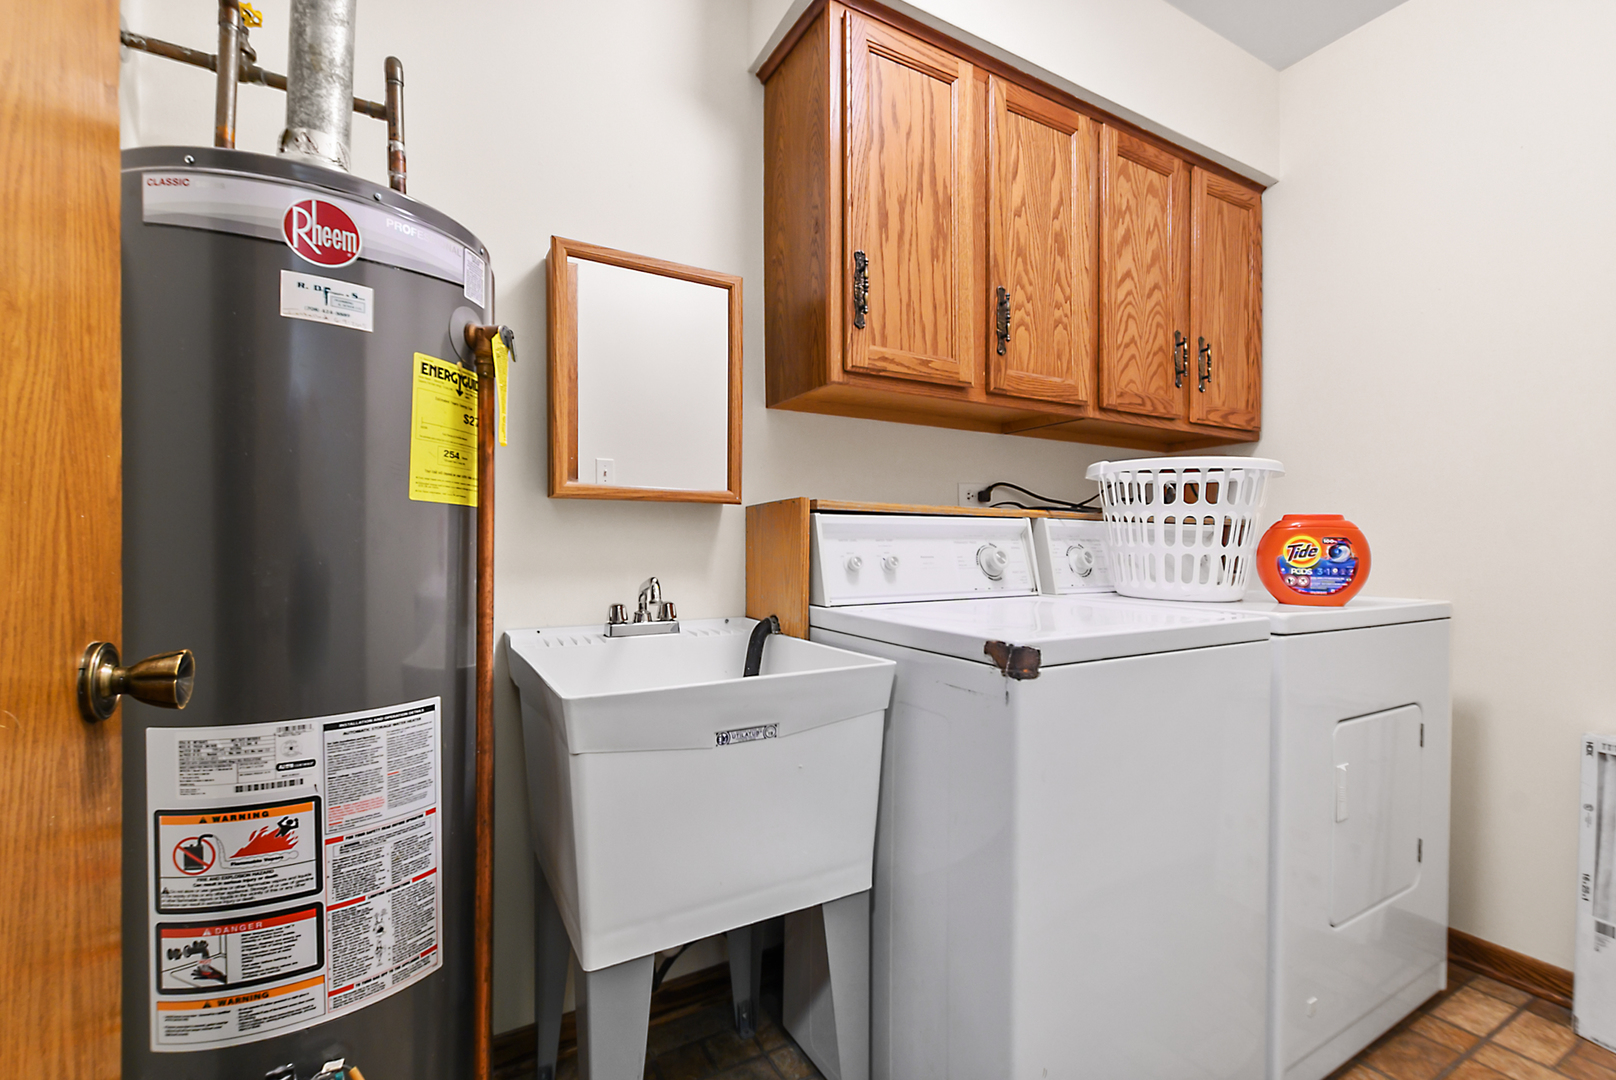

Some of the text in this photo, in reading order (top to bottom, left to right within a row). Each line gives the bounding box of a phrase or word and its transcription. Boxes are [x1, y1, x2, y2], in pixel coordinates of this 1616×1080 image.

[147, 177, 190, 187] CLASSIC
[292, 200, 357, 255] Rheem
[386, 218, 462, 258] PROFESONAL
[443, 449, 460, 460] 254
[1286, 542, 1319, 563] Tide
[1291, 568, 1313, 576] PODS
[1586, 741, 1594, 757] HDX
[212, 811, 269, 823] WARNING
[230, 855, 284, 867] Flammable Vapors
[214, 922, 263, 935] DANGER
[217, 991, 269, 1006] WARNING
